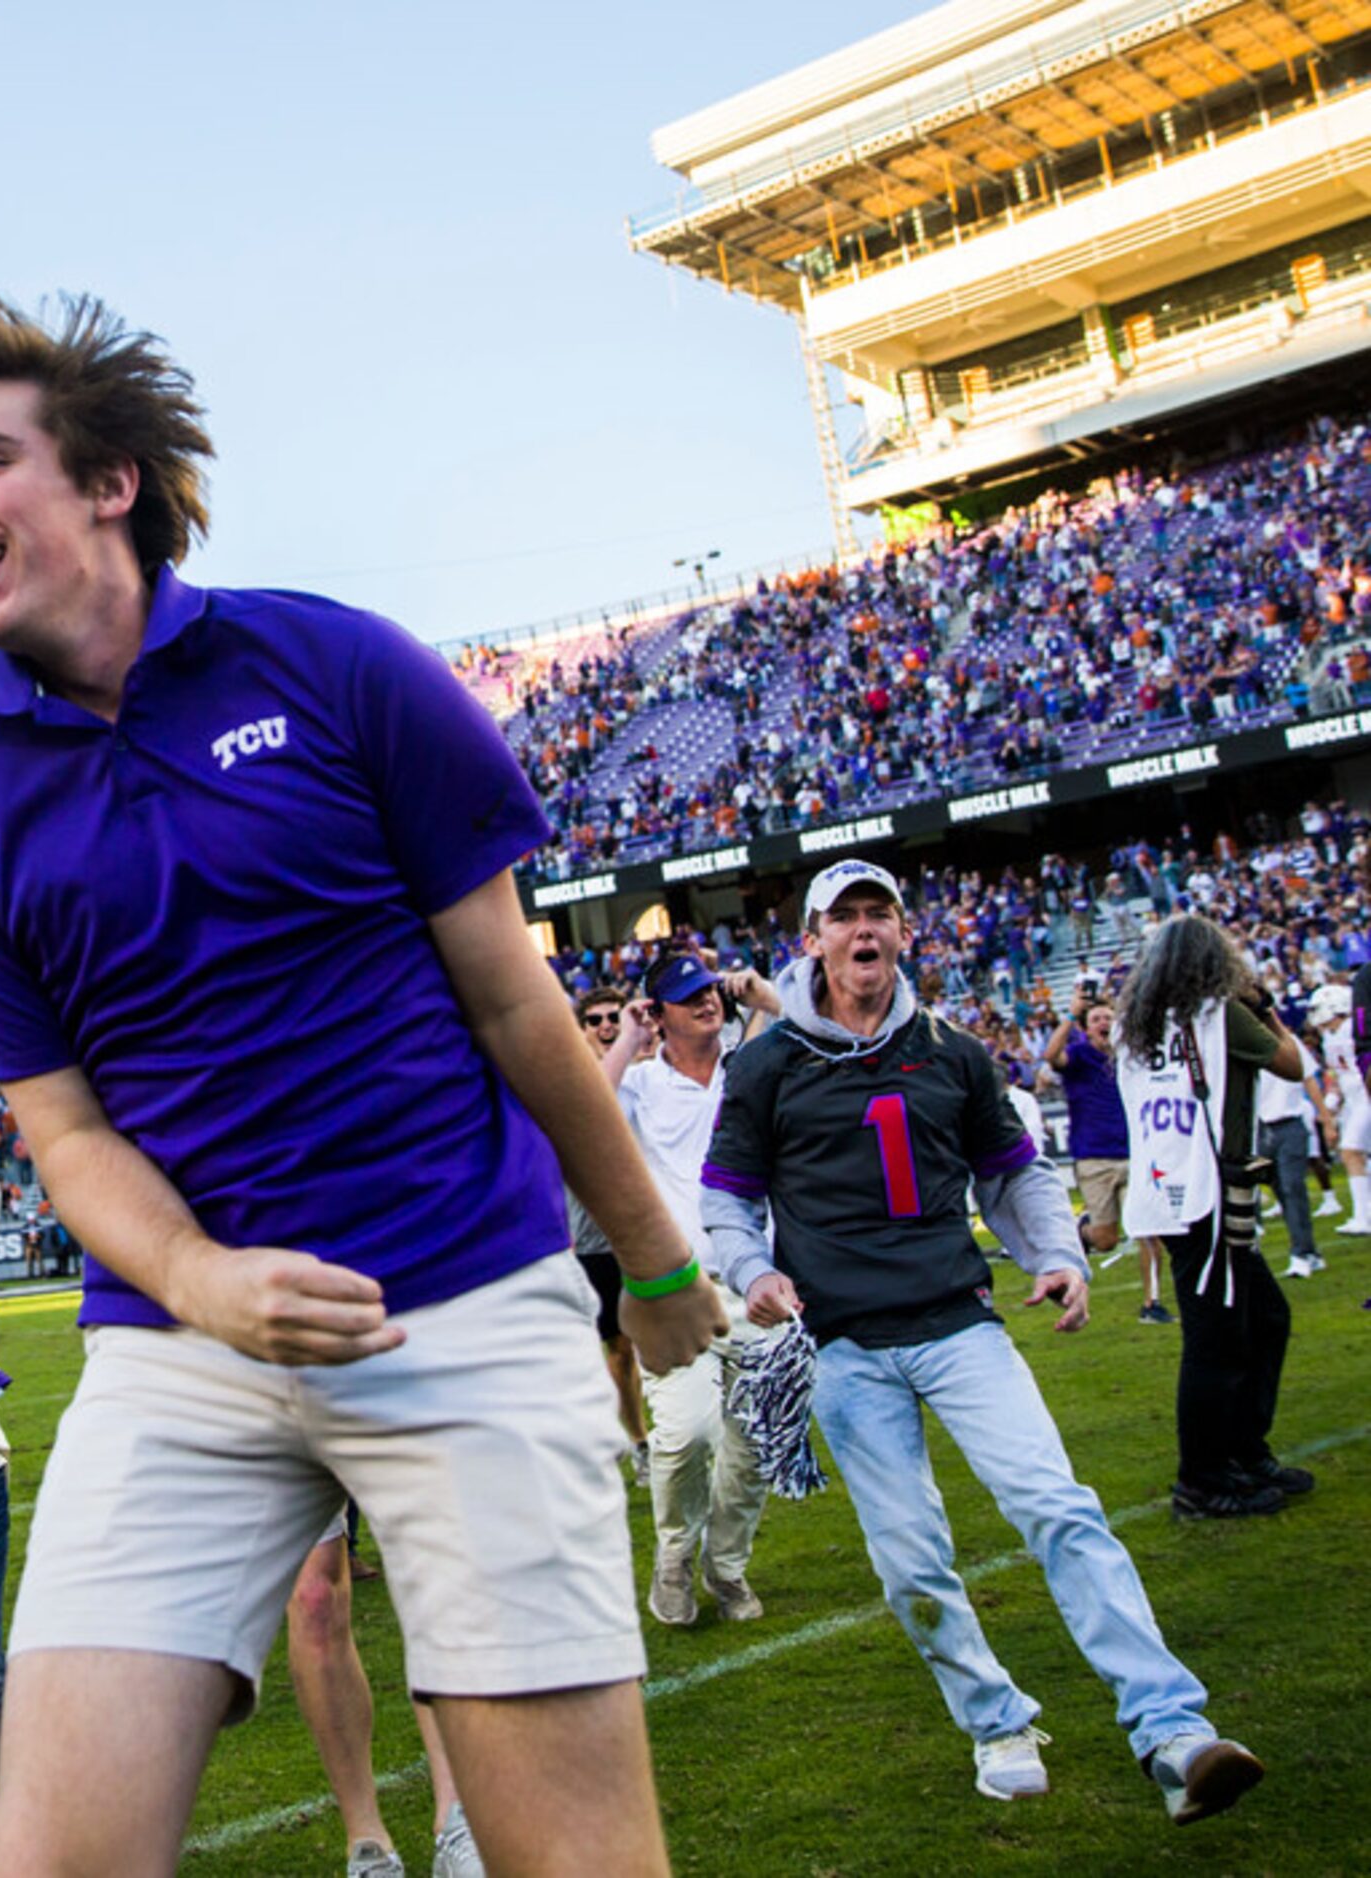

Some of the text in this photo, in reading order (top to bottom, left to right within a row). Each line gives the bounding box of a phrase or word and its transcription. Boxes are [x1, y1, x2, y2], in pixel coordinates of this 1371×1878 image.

[211, 716, 288, 770] TCU
[1284, 714, 1360, 750] MUSCLE
[1107, 744, 1220, 788] MUSCLE MILK
[861, 1092, 922, 1218] 1
